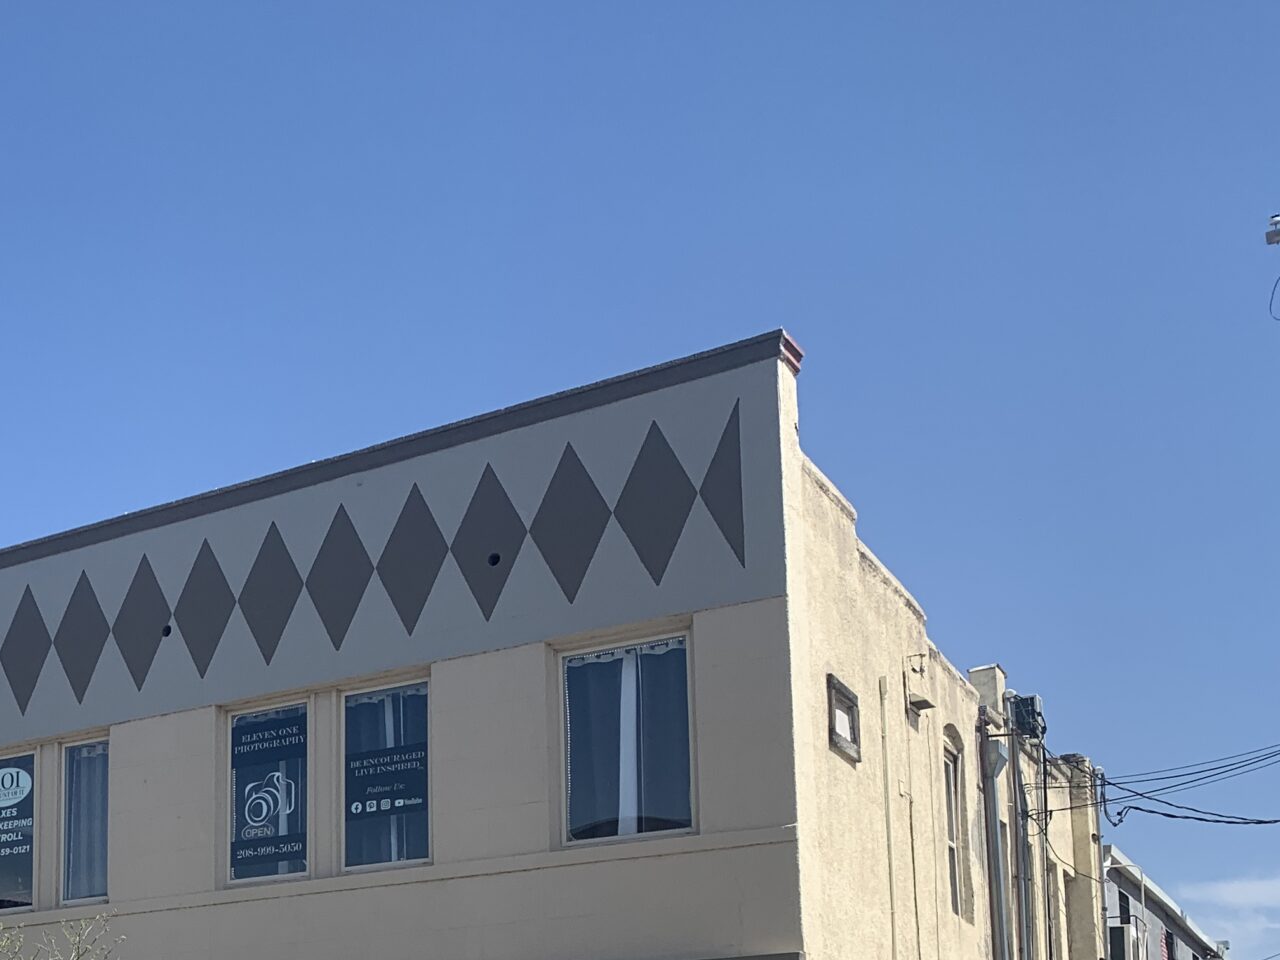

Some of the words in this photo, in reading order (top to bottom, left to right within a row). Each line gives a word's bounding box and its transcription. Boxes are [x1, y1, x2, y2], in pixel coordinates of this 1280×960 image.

[241, 729, 276, 743] ELEVEN
[279, 726, 299, 736] ONE
[234, 735, 305, 755] PHOTOGRAPHY
[350, 760, 361, 769] BE
[363, 751, 425, 767] ENCOURAGED
[355, 767, 376, 777] LIVE
[245, 827, 272, 838] OPEN
[236, 842, 303, 859] 208-999-5050
